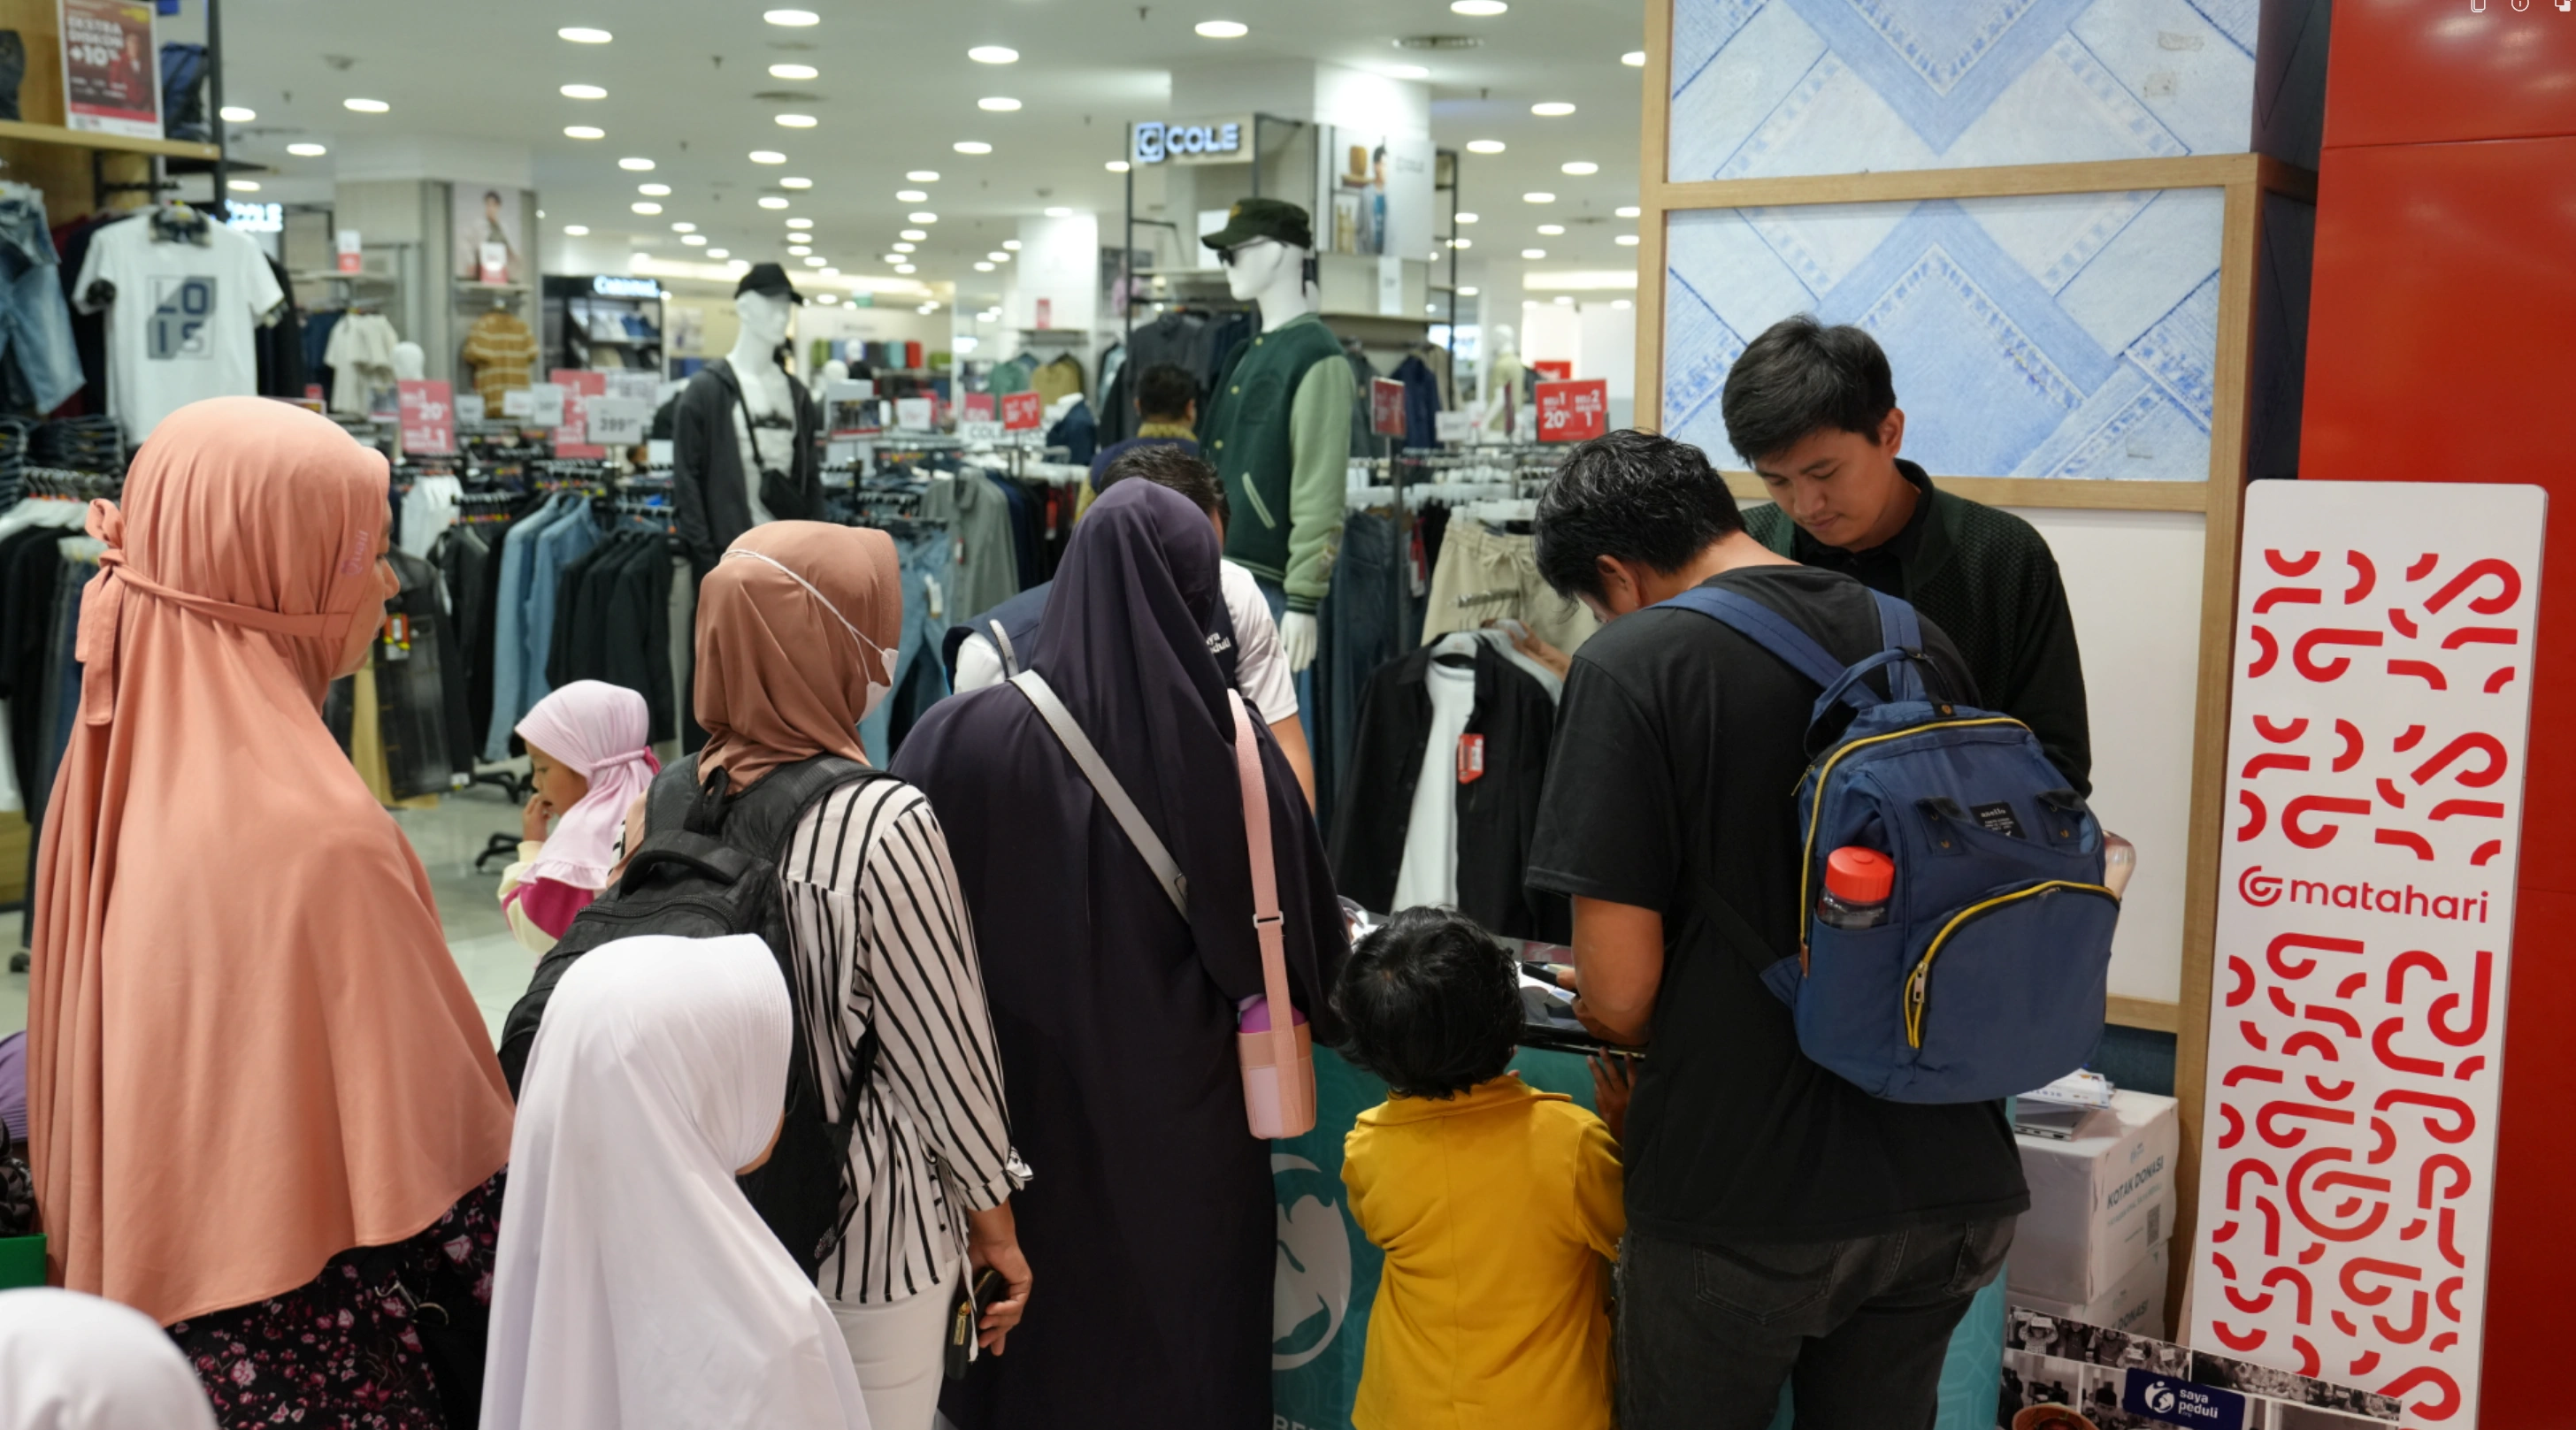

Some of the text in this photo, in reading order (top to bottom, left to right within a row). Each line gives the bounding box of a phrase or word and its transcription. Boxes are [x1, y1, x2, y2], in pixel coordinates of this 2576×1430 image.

[1167, 123, 1238, 154] COLE
[2289, 878, 2489, 923] matahari
[2107, 1176, 2134, 1210] KOTAK
[2178, 1401, 2219, 1419] peduli
[2179, 1388, 2209, 1404] saya
